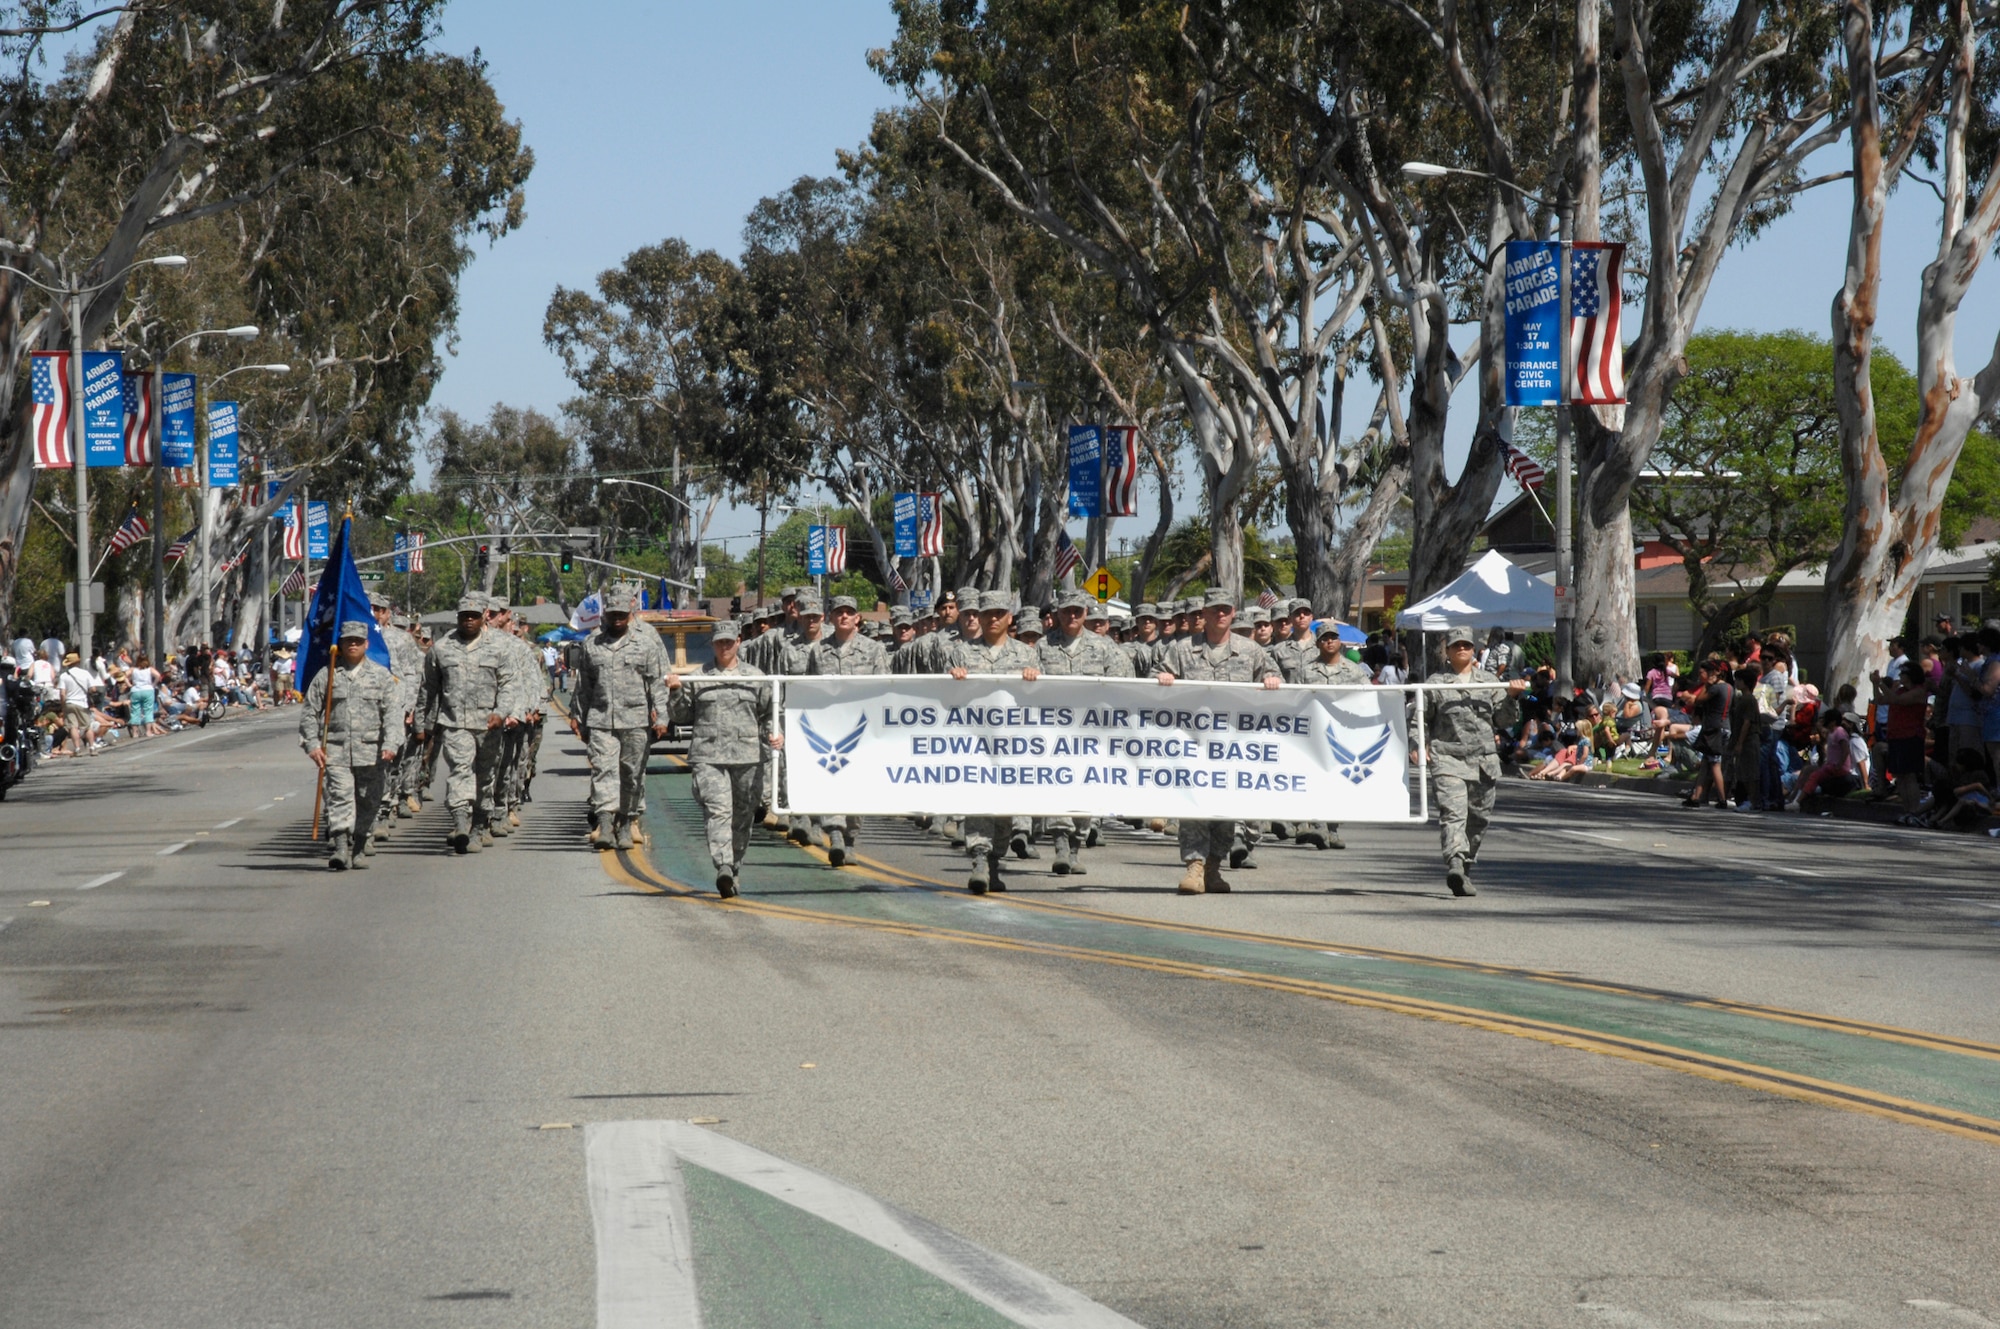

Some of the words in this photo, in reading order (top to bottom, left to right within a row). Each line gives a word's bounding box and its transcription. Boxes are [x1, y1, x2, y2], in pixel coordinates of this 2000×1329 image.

[1506, 250, 1553, 278] ARMED
[1507, 267, 1558, 297] FORCES
[1506, 285, 1560, 316] PARADE
[1523, 323, 1542, 331] MAY
[1527, 332, 1538, 340] 17
[1516, 342, 1534, 350] 1:30
[1536, 342, 1550, 350] PM
[86, 358, 116, 381] ARMED
[1507, 361, 1558, 370] TORRANCE
[1519, 370, 1544, 379] CIVIC
[85, 371, 119, 397] FORCES
[163, 378, 191, 393] ARMED
[1514, 379, 1552, 388] CENTER
[85, 386, 120, 411] PARADE
[163, 388, 194, 404] FORCES
[163, 399, 194, 415] PARADE
[208, 405, 233, 421] ARMED
[209, 415, 236, 430] FORCES
[209, 424, 237, 440] PARADE
[1070, 429, 1096, 445] ARMED
[1070, 439, 1099, 456] FORCES
[1070, 449, 1100, 466] PARADE
[884, 707, 936, 726] LOS
[946, 707, 1073, 726] ANGELES
[1082, 709, 1129, 727] AIR
[1139, 710, 1228, 731] FORCE
[1238, 713, 1310, 735] BASE
[912, 737, 1045, 755] EDWARDS
[1053, 737, 1099, 755] AIR
[1109, 738, 1198, 758] FORCE
[1208, 742, 1278, 762] BASE
[886, 765, 1073, 785] VANDENBERG
[1083, 766, 1127, 785] AIR
[1138, 768, 1227, 789] FORCE
[1237, 771, 1307, 792] BASE
